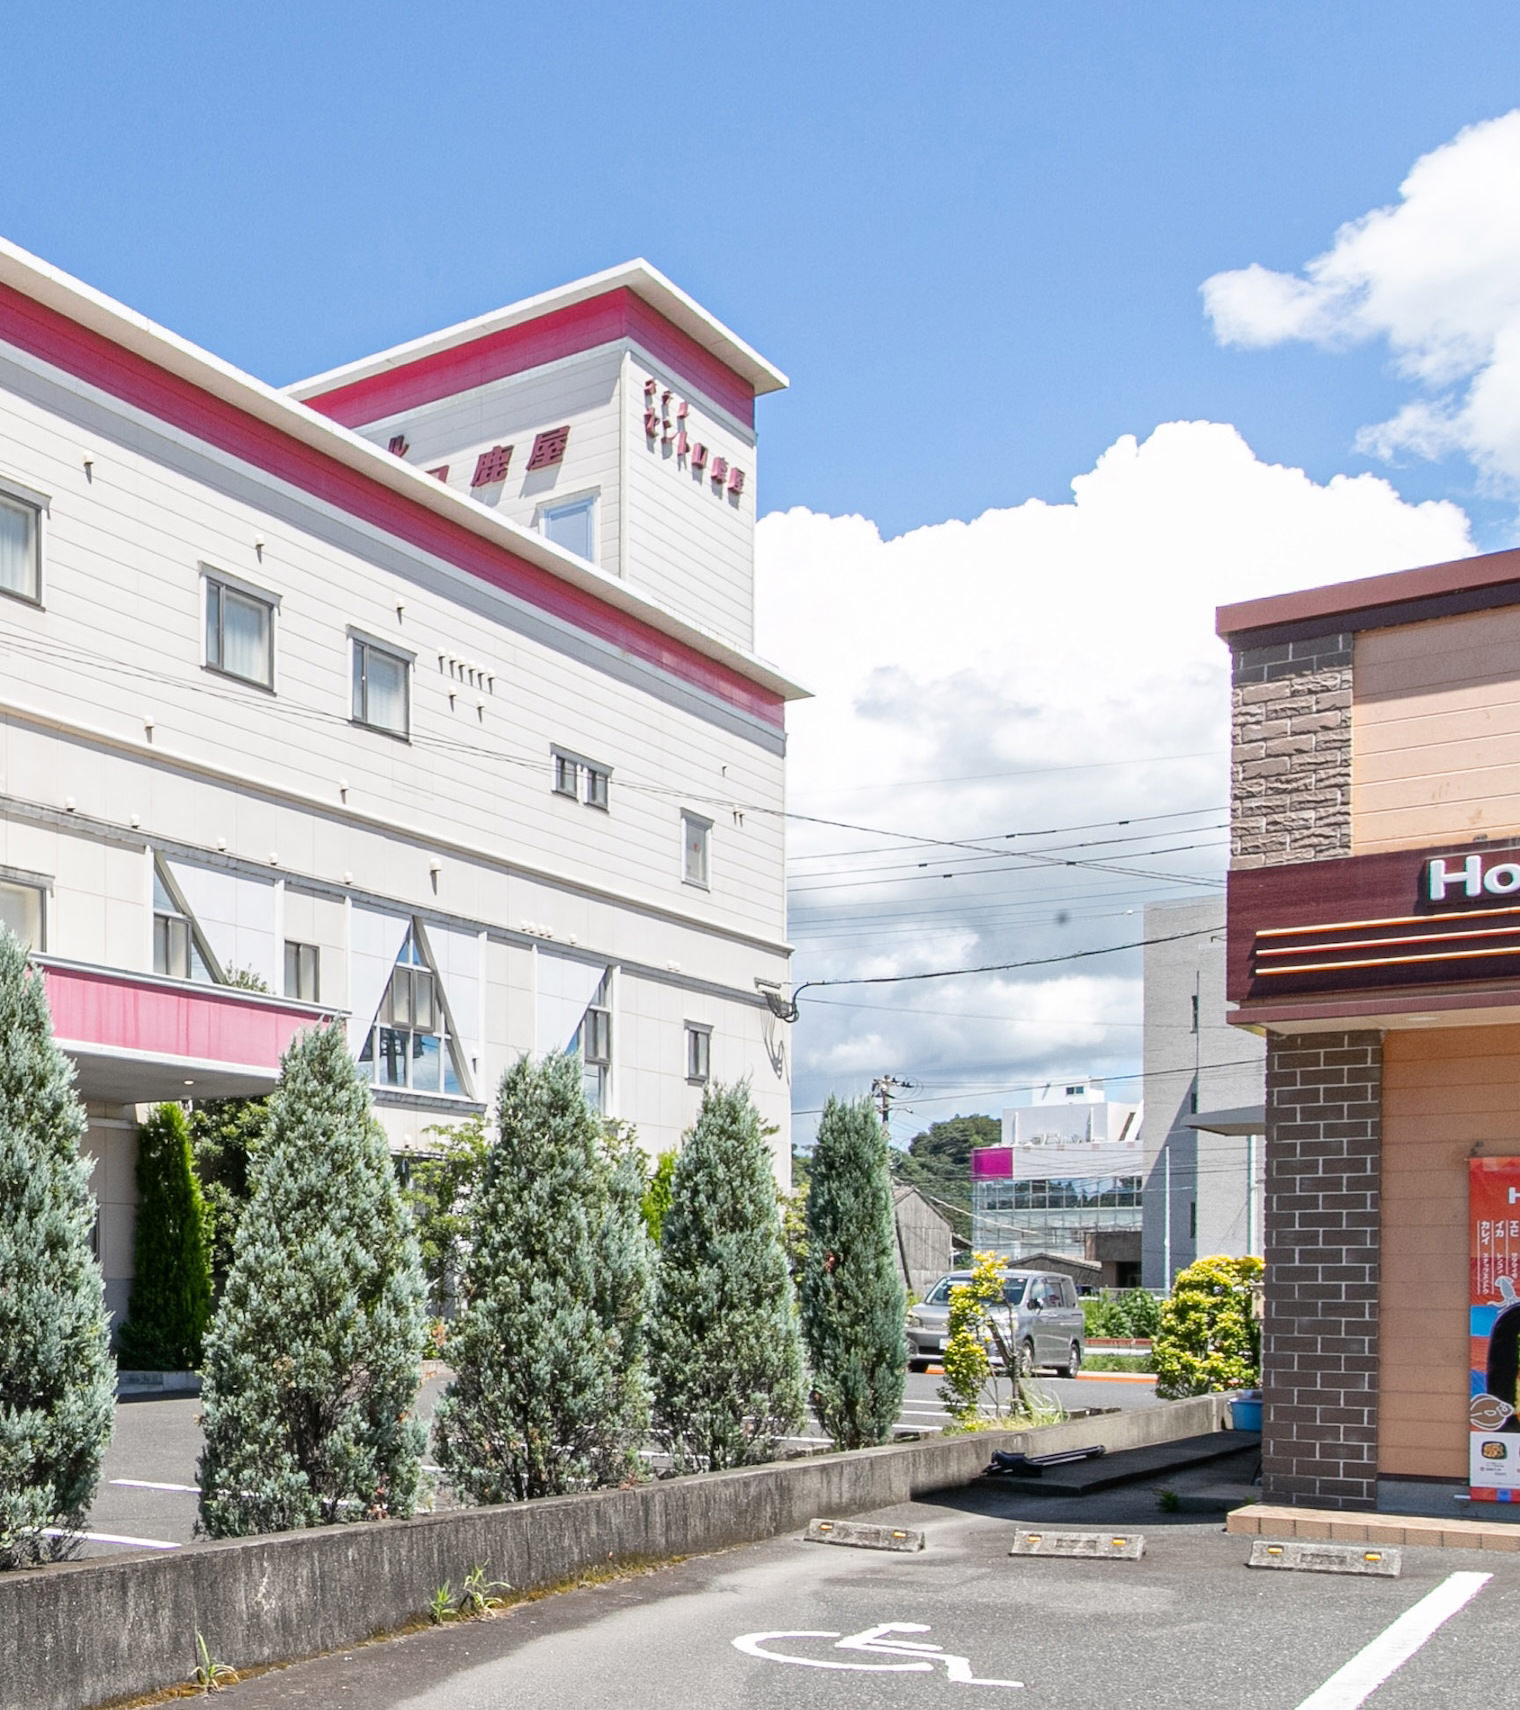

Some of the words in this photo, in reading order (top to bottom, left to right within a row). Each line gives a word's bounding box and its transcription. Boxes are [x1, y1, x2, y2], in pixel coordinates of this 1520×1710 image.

[1429, 855, 1520, 900] Ho
[1481, 1220, 1490, 1245] カレイ
[1495, 1220, 1504, 1237] イカ
